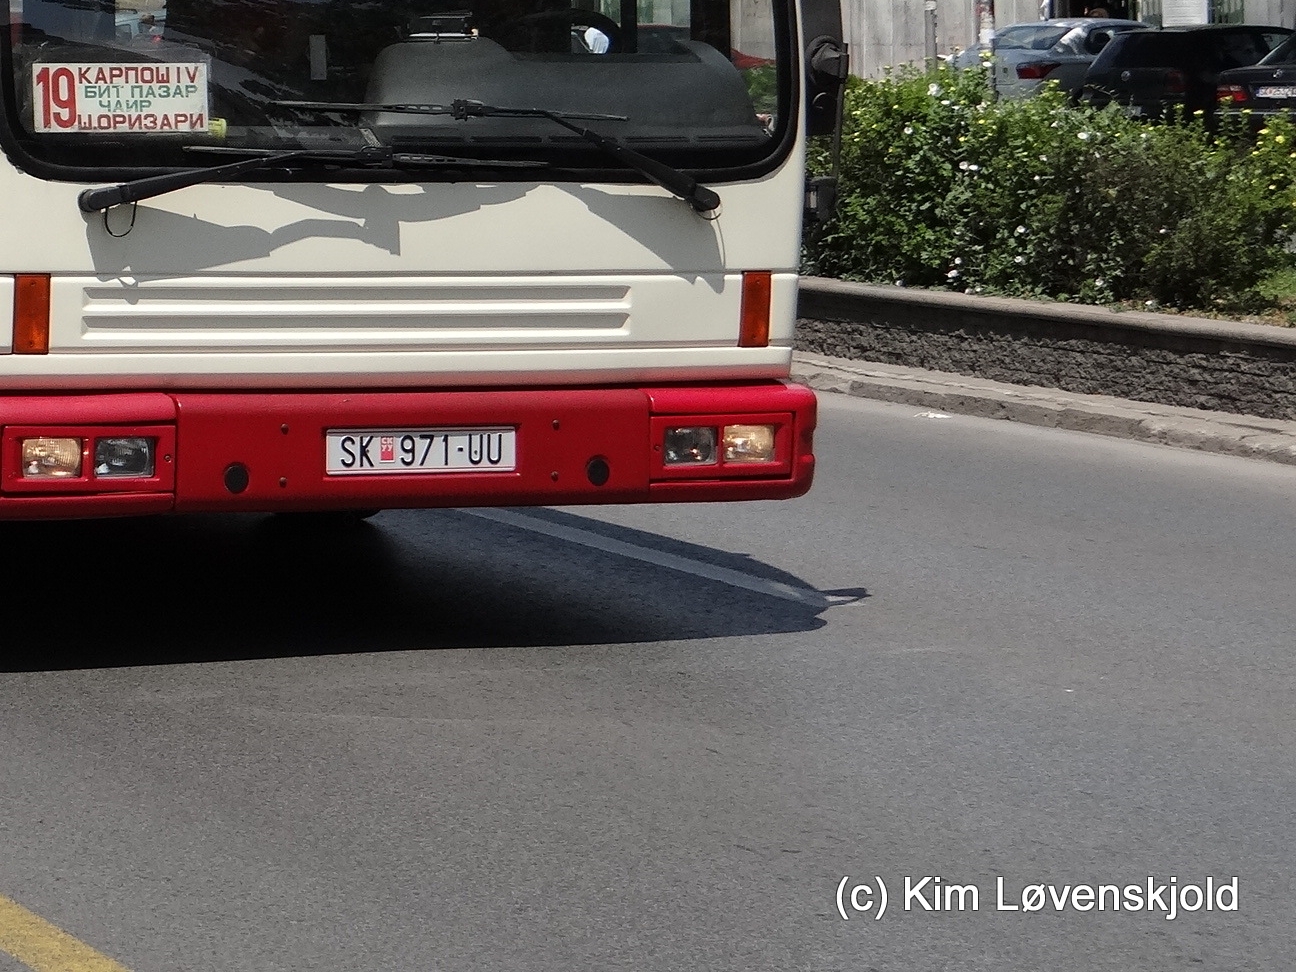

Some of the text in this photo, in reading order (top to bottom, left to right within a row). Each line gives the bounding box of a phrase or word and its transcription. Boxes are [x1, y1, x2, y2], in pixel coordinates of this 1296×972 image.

[78, 67, 170, 84] КАРПОШ
[36, 67, 77, 129] 19
[84, 85, 198, 99] БИТ ПАЗАР
[99, 99, 152, 112] ЧАИР
[340, 433, 503, 468] SK 971-UU
